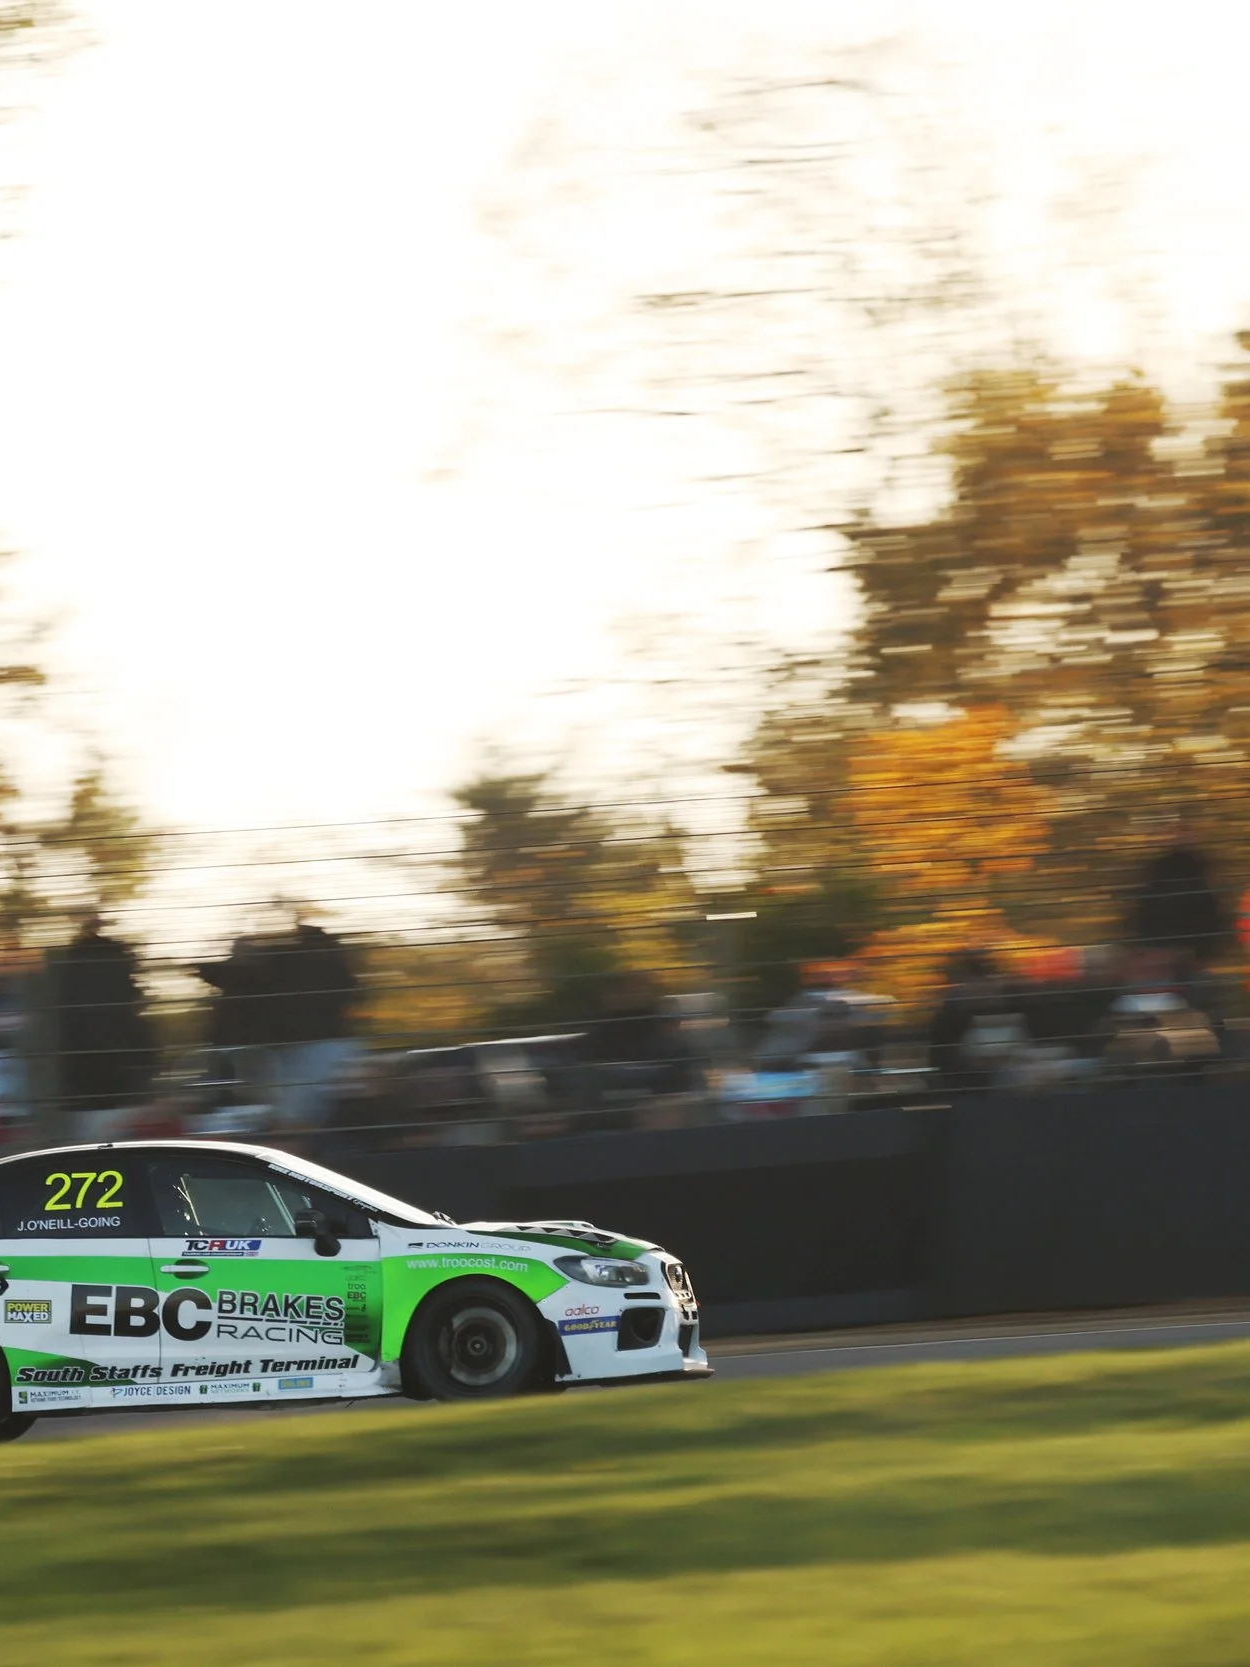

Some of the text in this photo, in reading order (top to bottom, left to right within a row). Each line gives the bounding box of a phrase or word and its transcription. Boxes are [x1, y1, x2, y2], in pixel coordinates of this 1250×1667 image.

[44, 1170, 124, 1211] 272
[17, 1216, 121, 1231] J.O'NEILL-GOING
[480, 1242, 531, 1252] GROUP
[406, 1256, 529, 1273] www.troocost.com
[6, 1302, 49, 1313] POWER
[69, 1284, 213, 1342] EBC
[218, 1290, 345, 1321] BRAKES
[565, 1303, 600, 1317] aalco
[6, 1311, 49, 1323] MAXED
[564, 1319, 618, 1332] GOODYEAR
[217, 1324, 344, 1346] RACING
[16, 1355, 360, 1383] South Staffs Freight Terminal
[123, 1385, 191, 1397] JOYCE DESIGN
